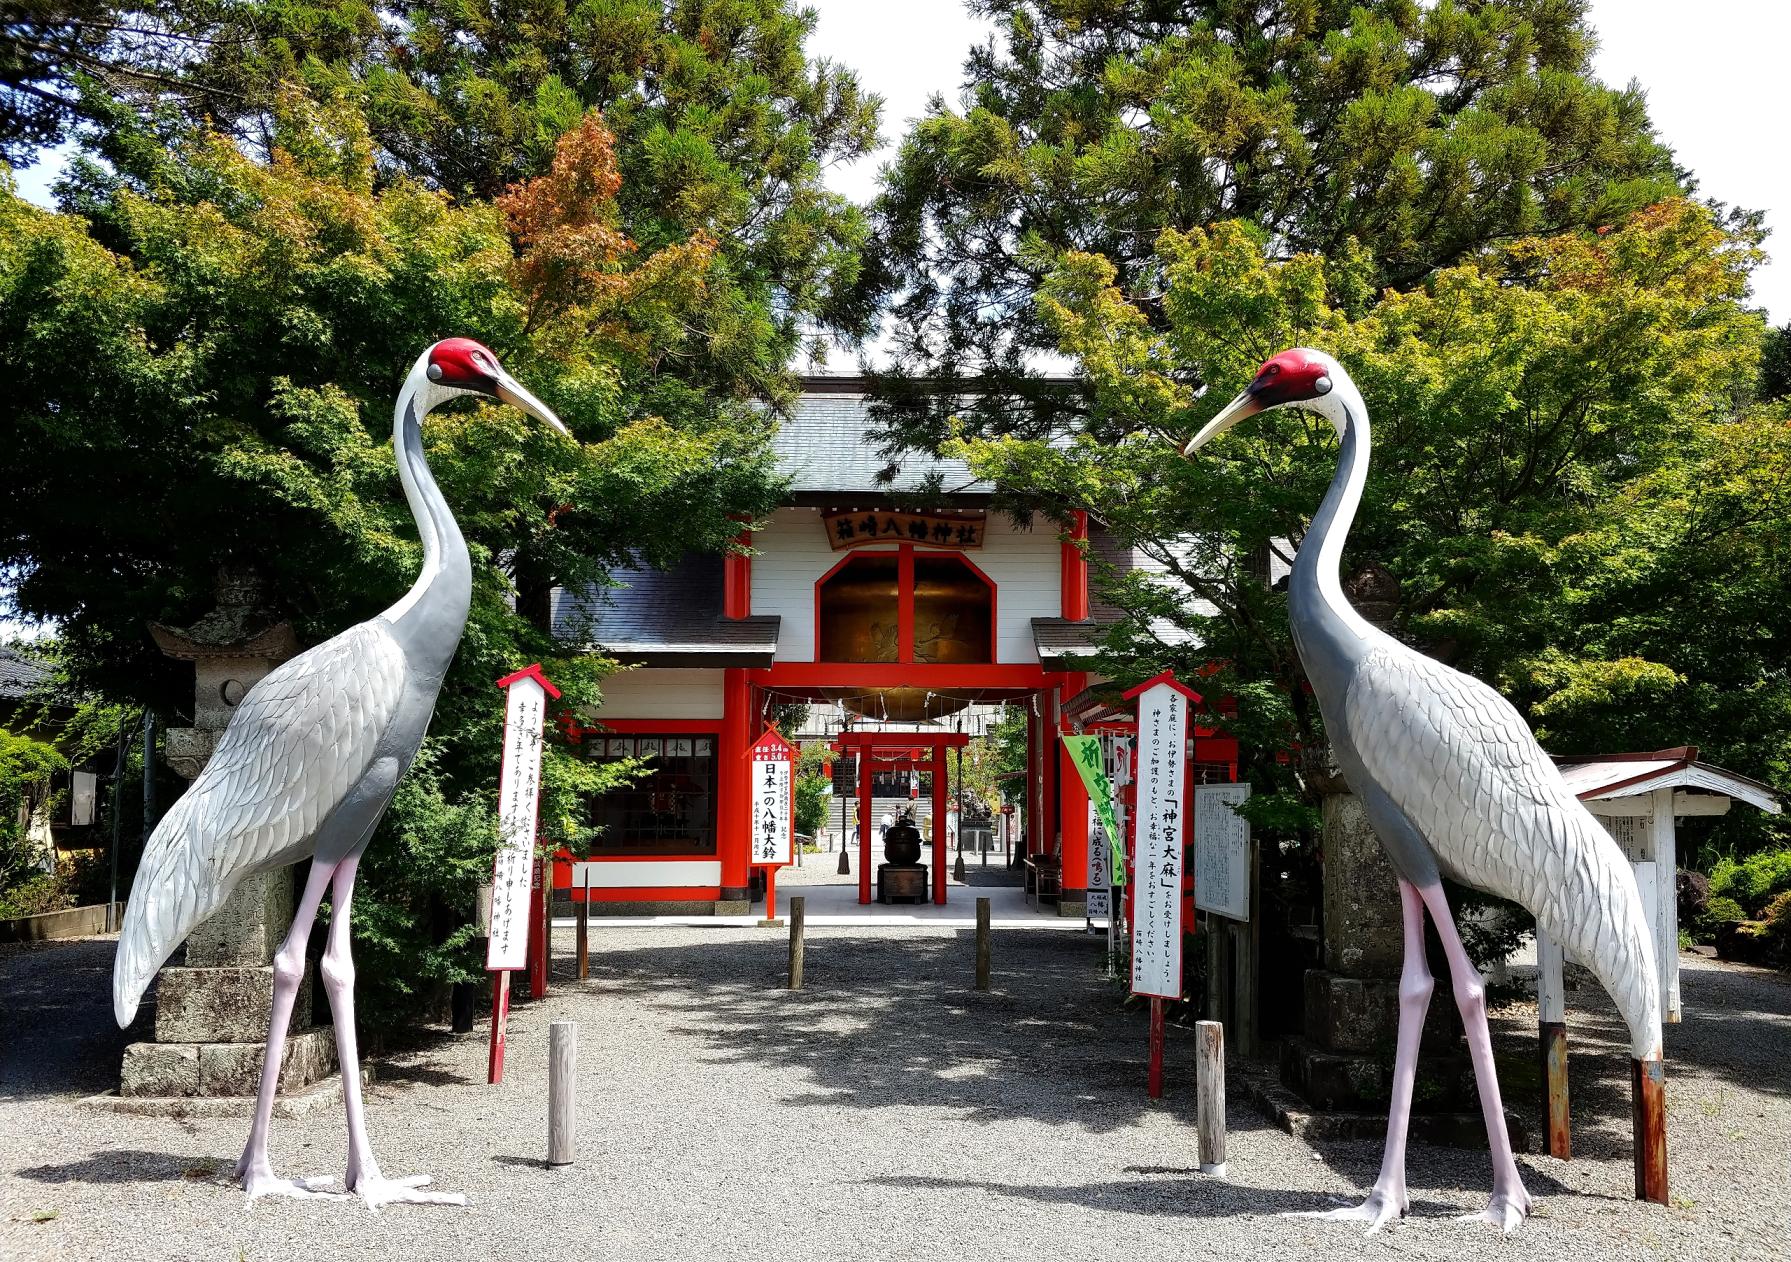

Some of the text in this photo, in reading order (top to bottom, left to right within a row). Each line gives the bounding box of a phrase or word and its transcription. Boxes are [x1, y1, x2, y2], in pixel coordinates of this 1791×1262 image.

[836, 514, 976, 544] 箱崎八幡神社
[762, 763, 777, 859] 日本一の八幡大鈴
